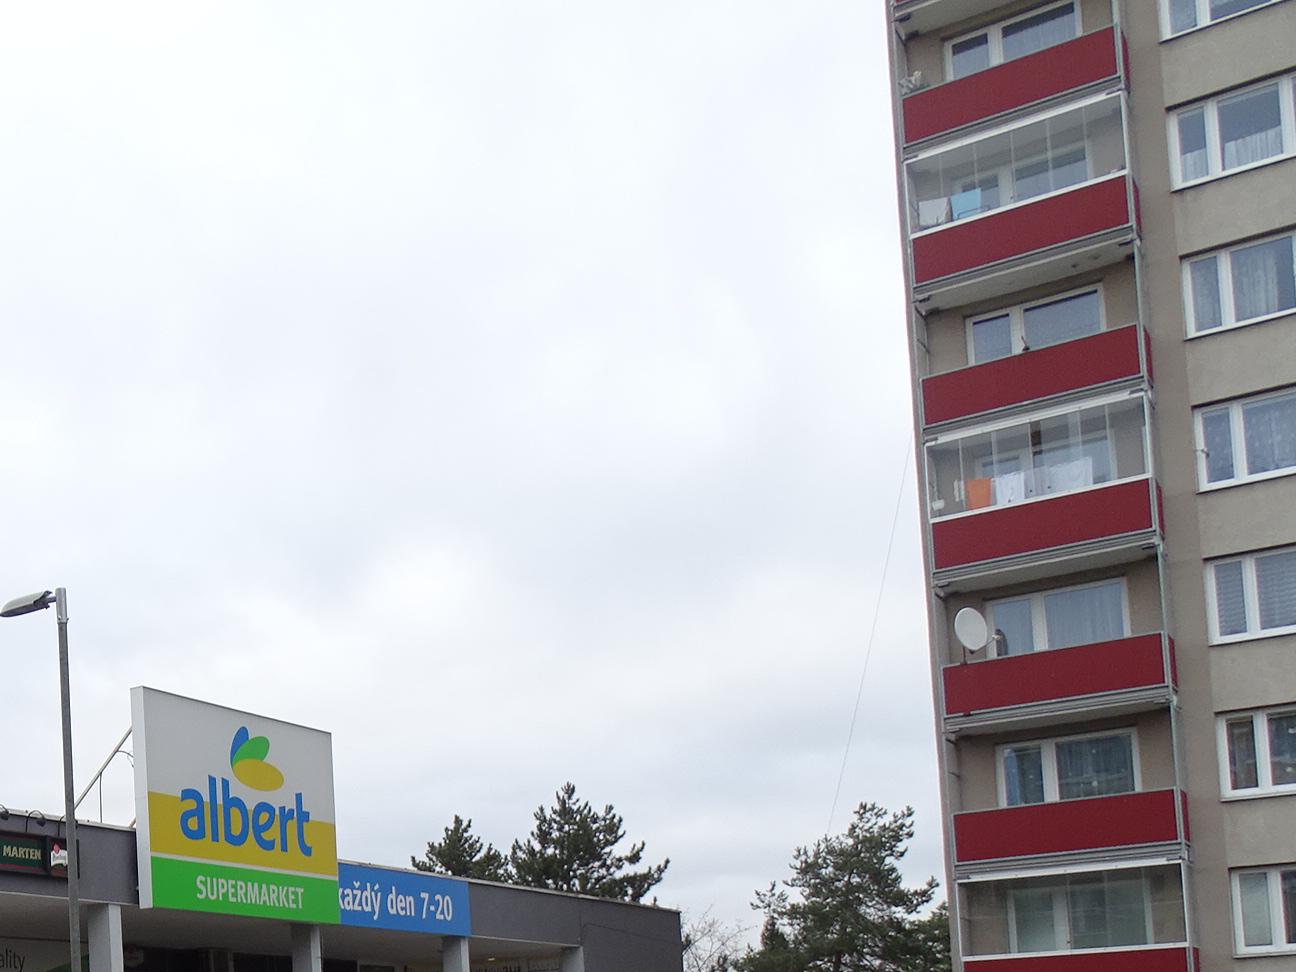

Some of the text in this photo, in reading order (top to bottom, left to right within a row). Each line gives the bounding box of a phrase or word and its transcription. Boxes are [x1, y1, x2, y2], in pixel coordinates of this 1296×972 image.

[179, 774, 313, 857] albert
[3, 847, 42, 861] MARTEN
[196, 875, 304, 909] SUPERMARKET
[387, 885, 415, 916] den
[420, 892, 453, 921] 7-20
